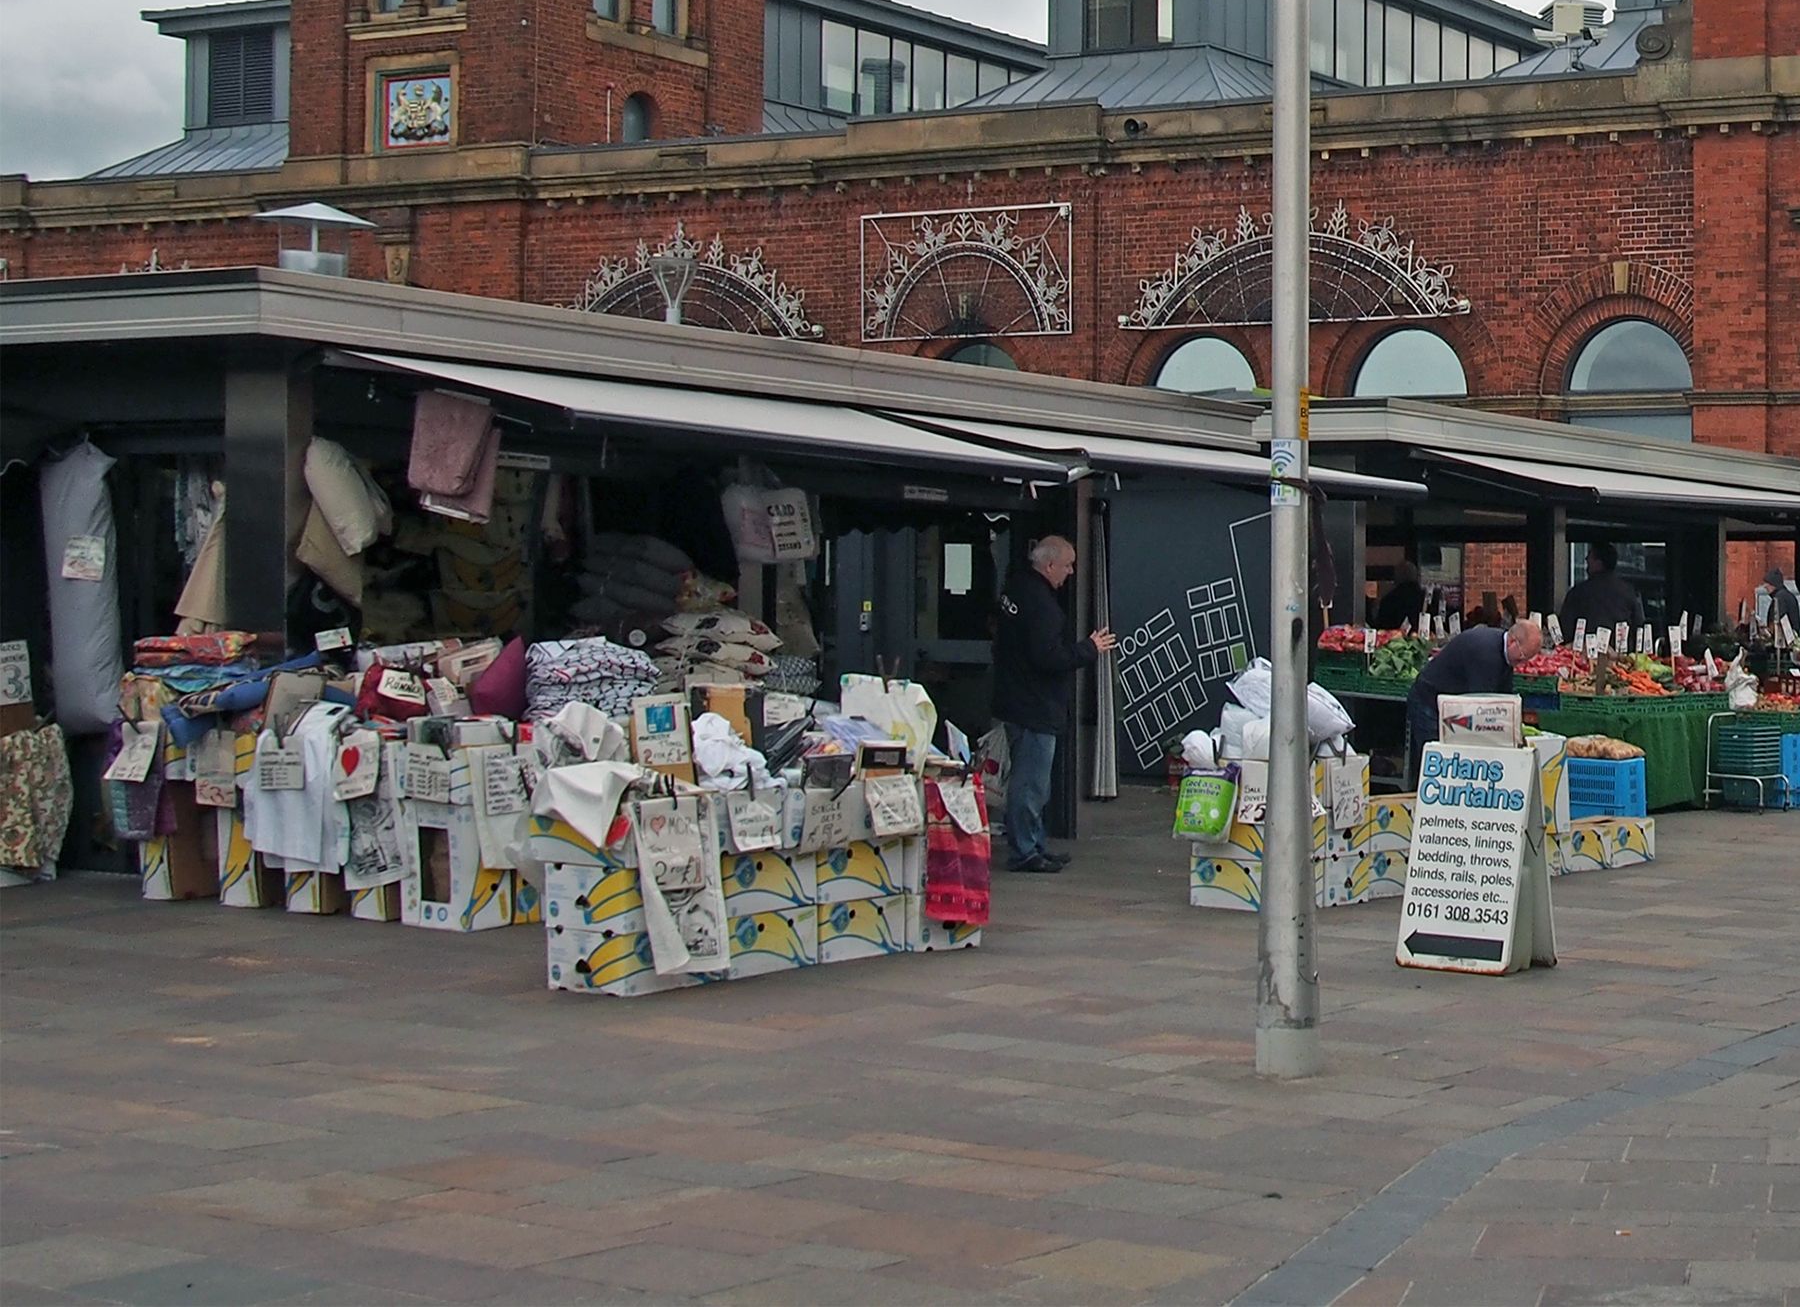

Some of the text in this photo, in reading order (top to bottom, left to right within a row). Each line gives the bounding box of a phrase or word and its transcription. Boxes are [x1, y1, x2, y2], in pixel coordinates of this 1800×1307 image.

[1422, 750, 1504, 783] Brians
[1420, 778, 1525, 812] Curtains
[1419, 815, 1518, 835] pelmets, scarves,
[1418, 833, 1516, 852] valances, linings,
[1417, 849, 1512, 870] bedding, throws,
[655, 860, 667, 885] 2
[1409, 866, 1515, 888] blinds, rails, poles,
[1411, 885, 1509, 904] accessories etc...
[1407, 902, 1509, 926] 0161 308 3543
